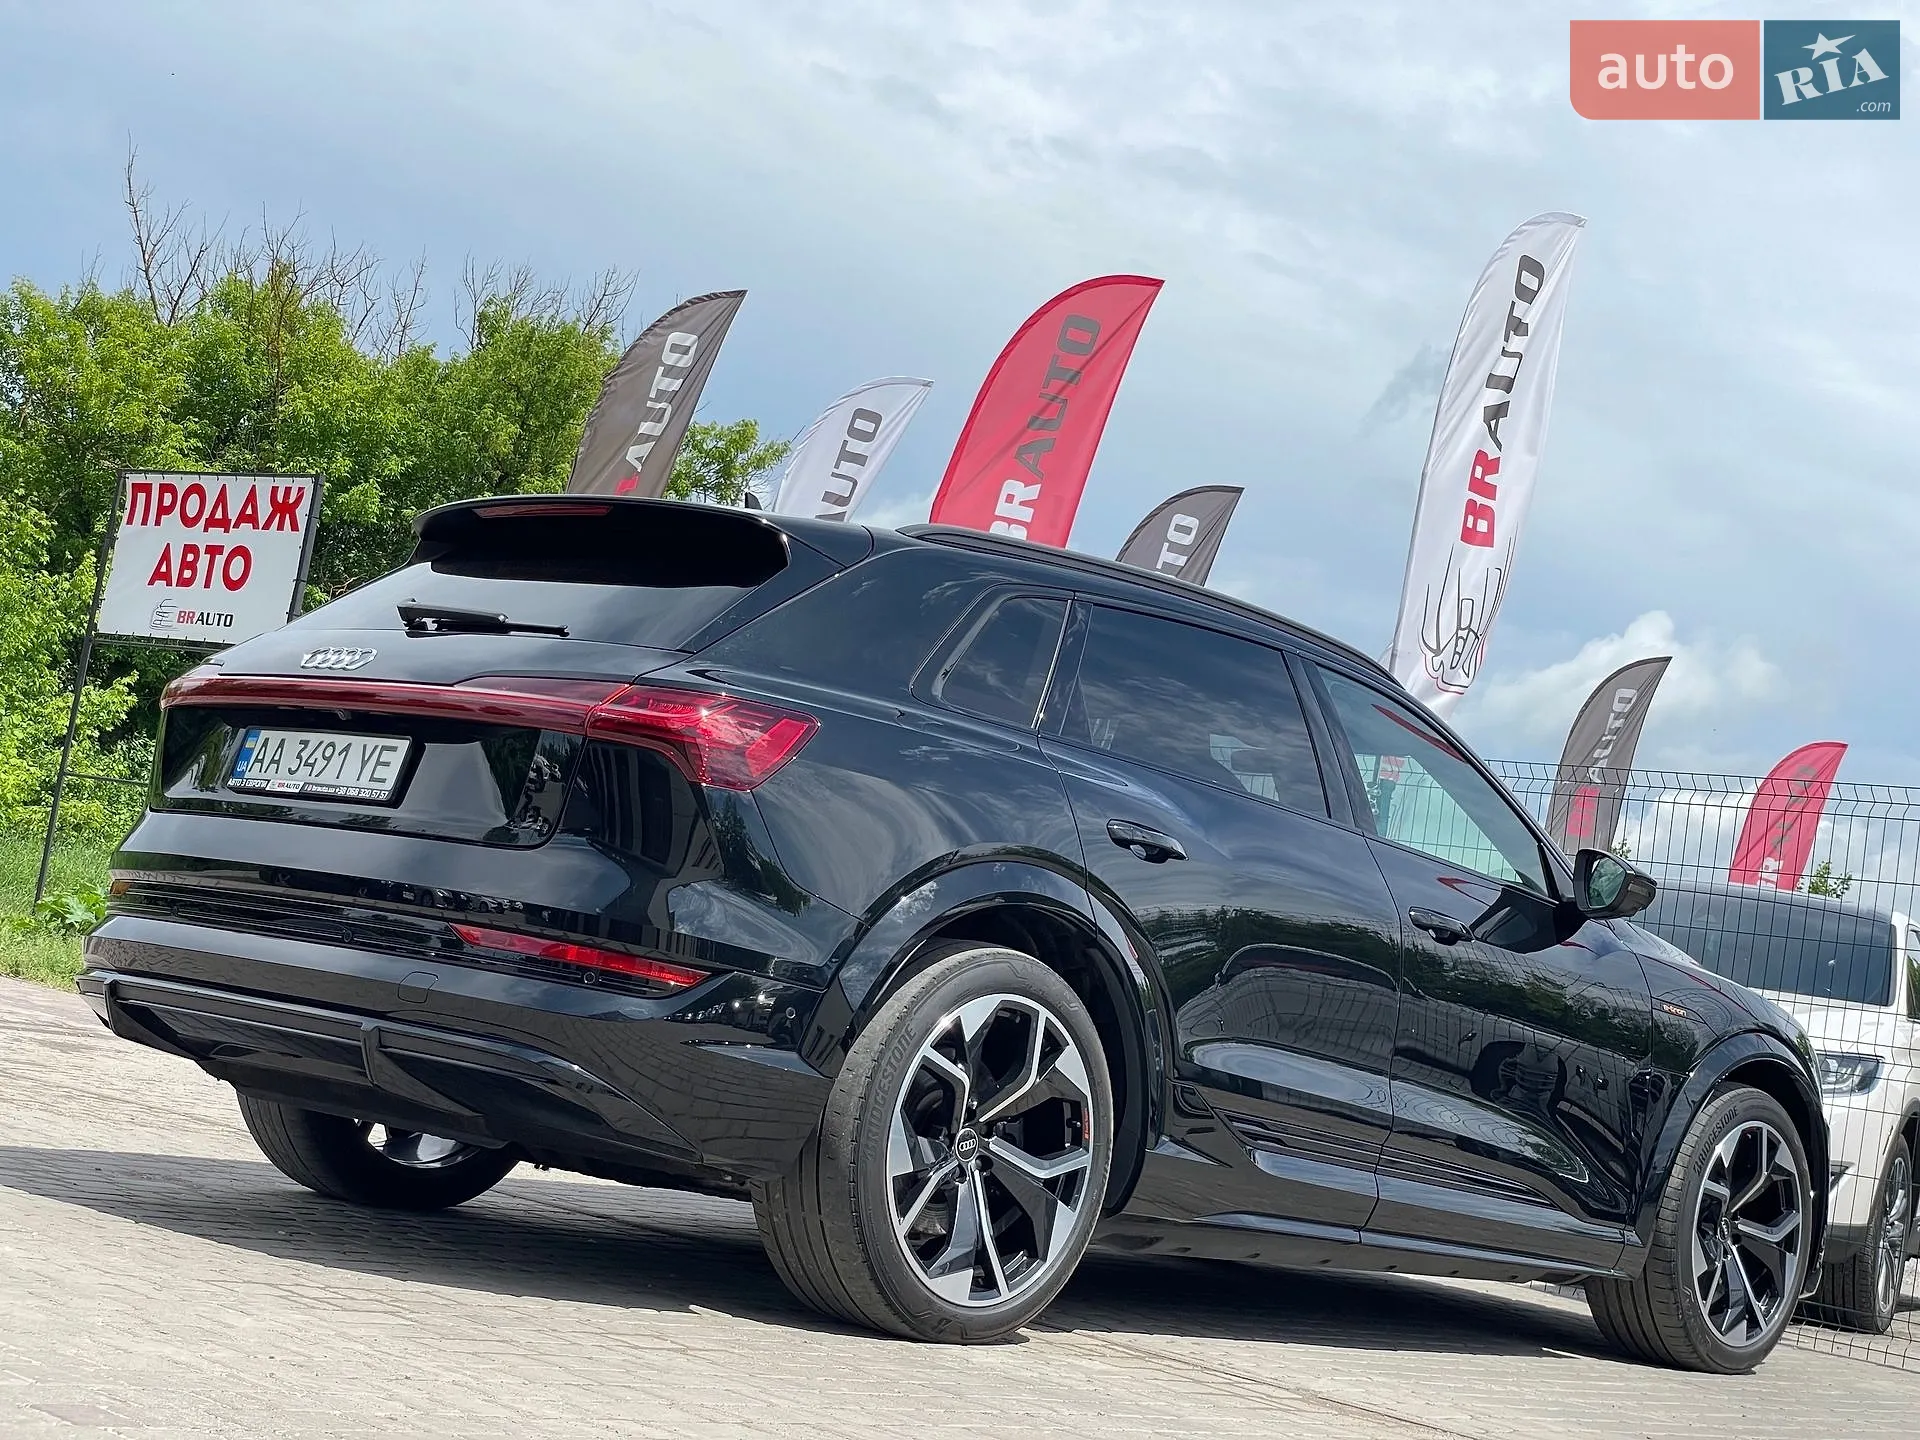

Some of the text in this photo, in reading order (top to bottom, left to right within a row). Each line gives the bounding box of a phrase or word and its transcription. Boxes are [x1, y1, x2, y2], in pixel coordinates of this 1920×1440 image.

[1460, 253, 1546, 549] BRAUTO
[814, 407, 883, 521] UTO
[125, 482, 306, 534] ПРОДАЖ
[147, 542, 253, 592] АВТО
[1155, 513, 1200, 577] TO
[176, 610, 234, 628] BRAUTO
[236, 760, 248, 772] UA
[248, 737, 399, 783] AA 3491 YE
[1692, 1106, 1739, 1177] BRIDGESTONE
